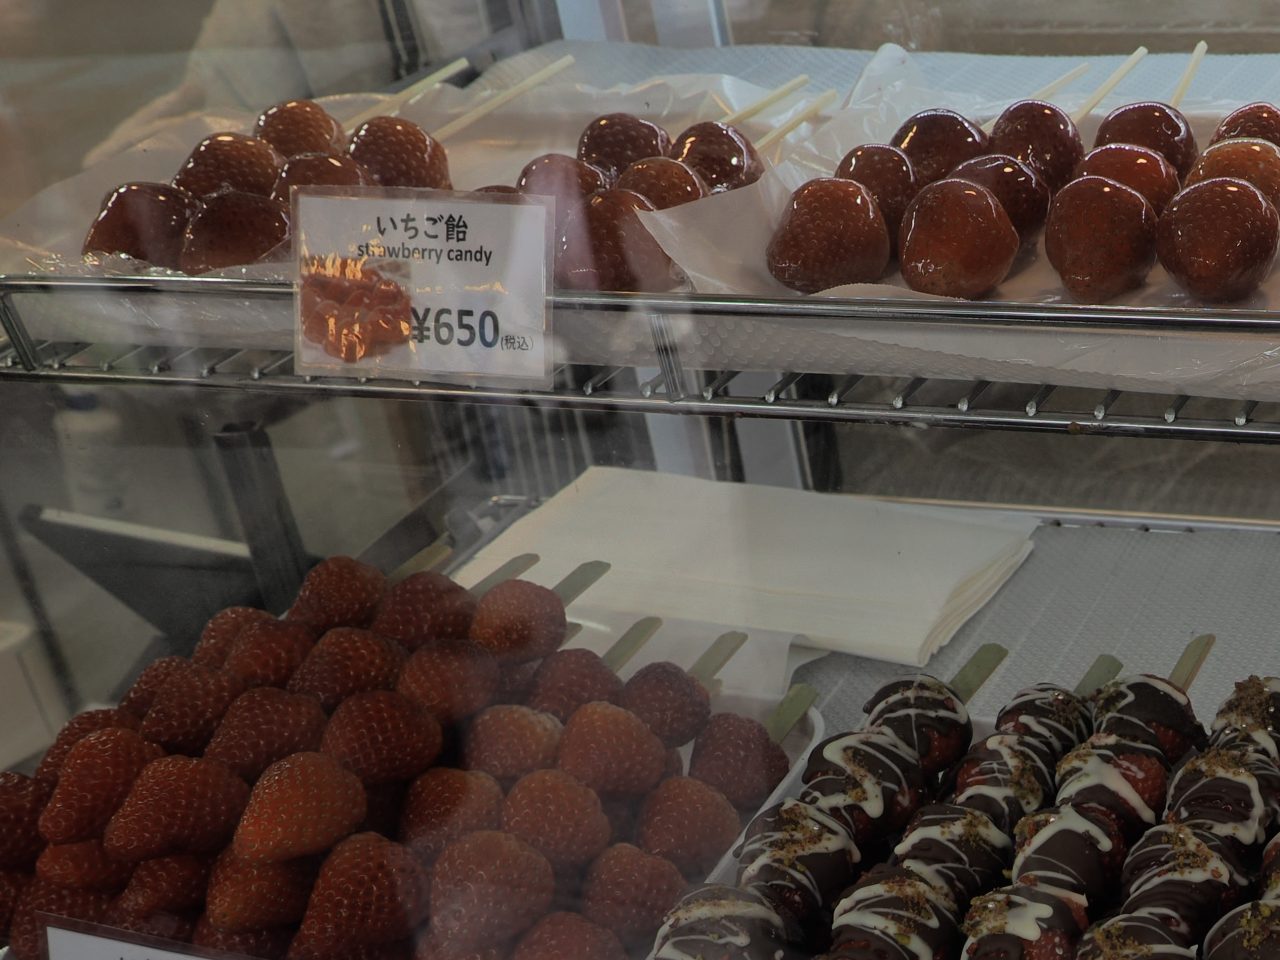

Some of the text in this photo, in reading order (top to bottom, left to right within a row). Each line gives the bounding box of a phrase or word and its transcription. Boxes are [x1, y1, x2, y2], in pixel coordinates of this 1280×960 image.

[376, 213, 469, 243] いちご飴
[357, 243, 493, 266] strawberry candy
[411, 307, 500, 348] ¥650
